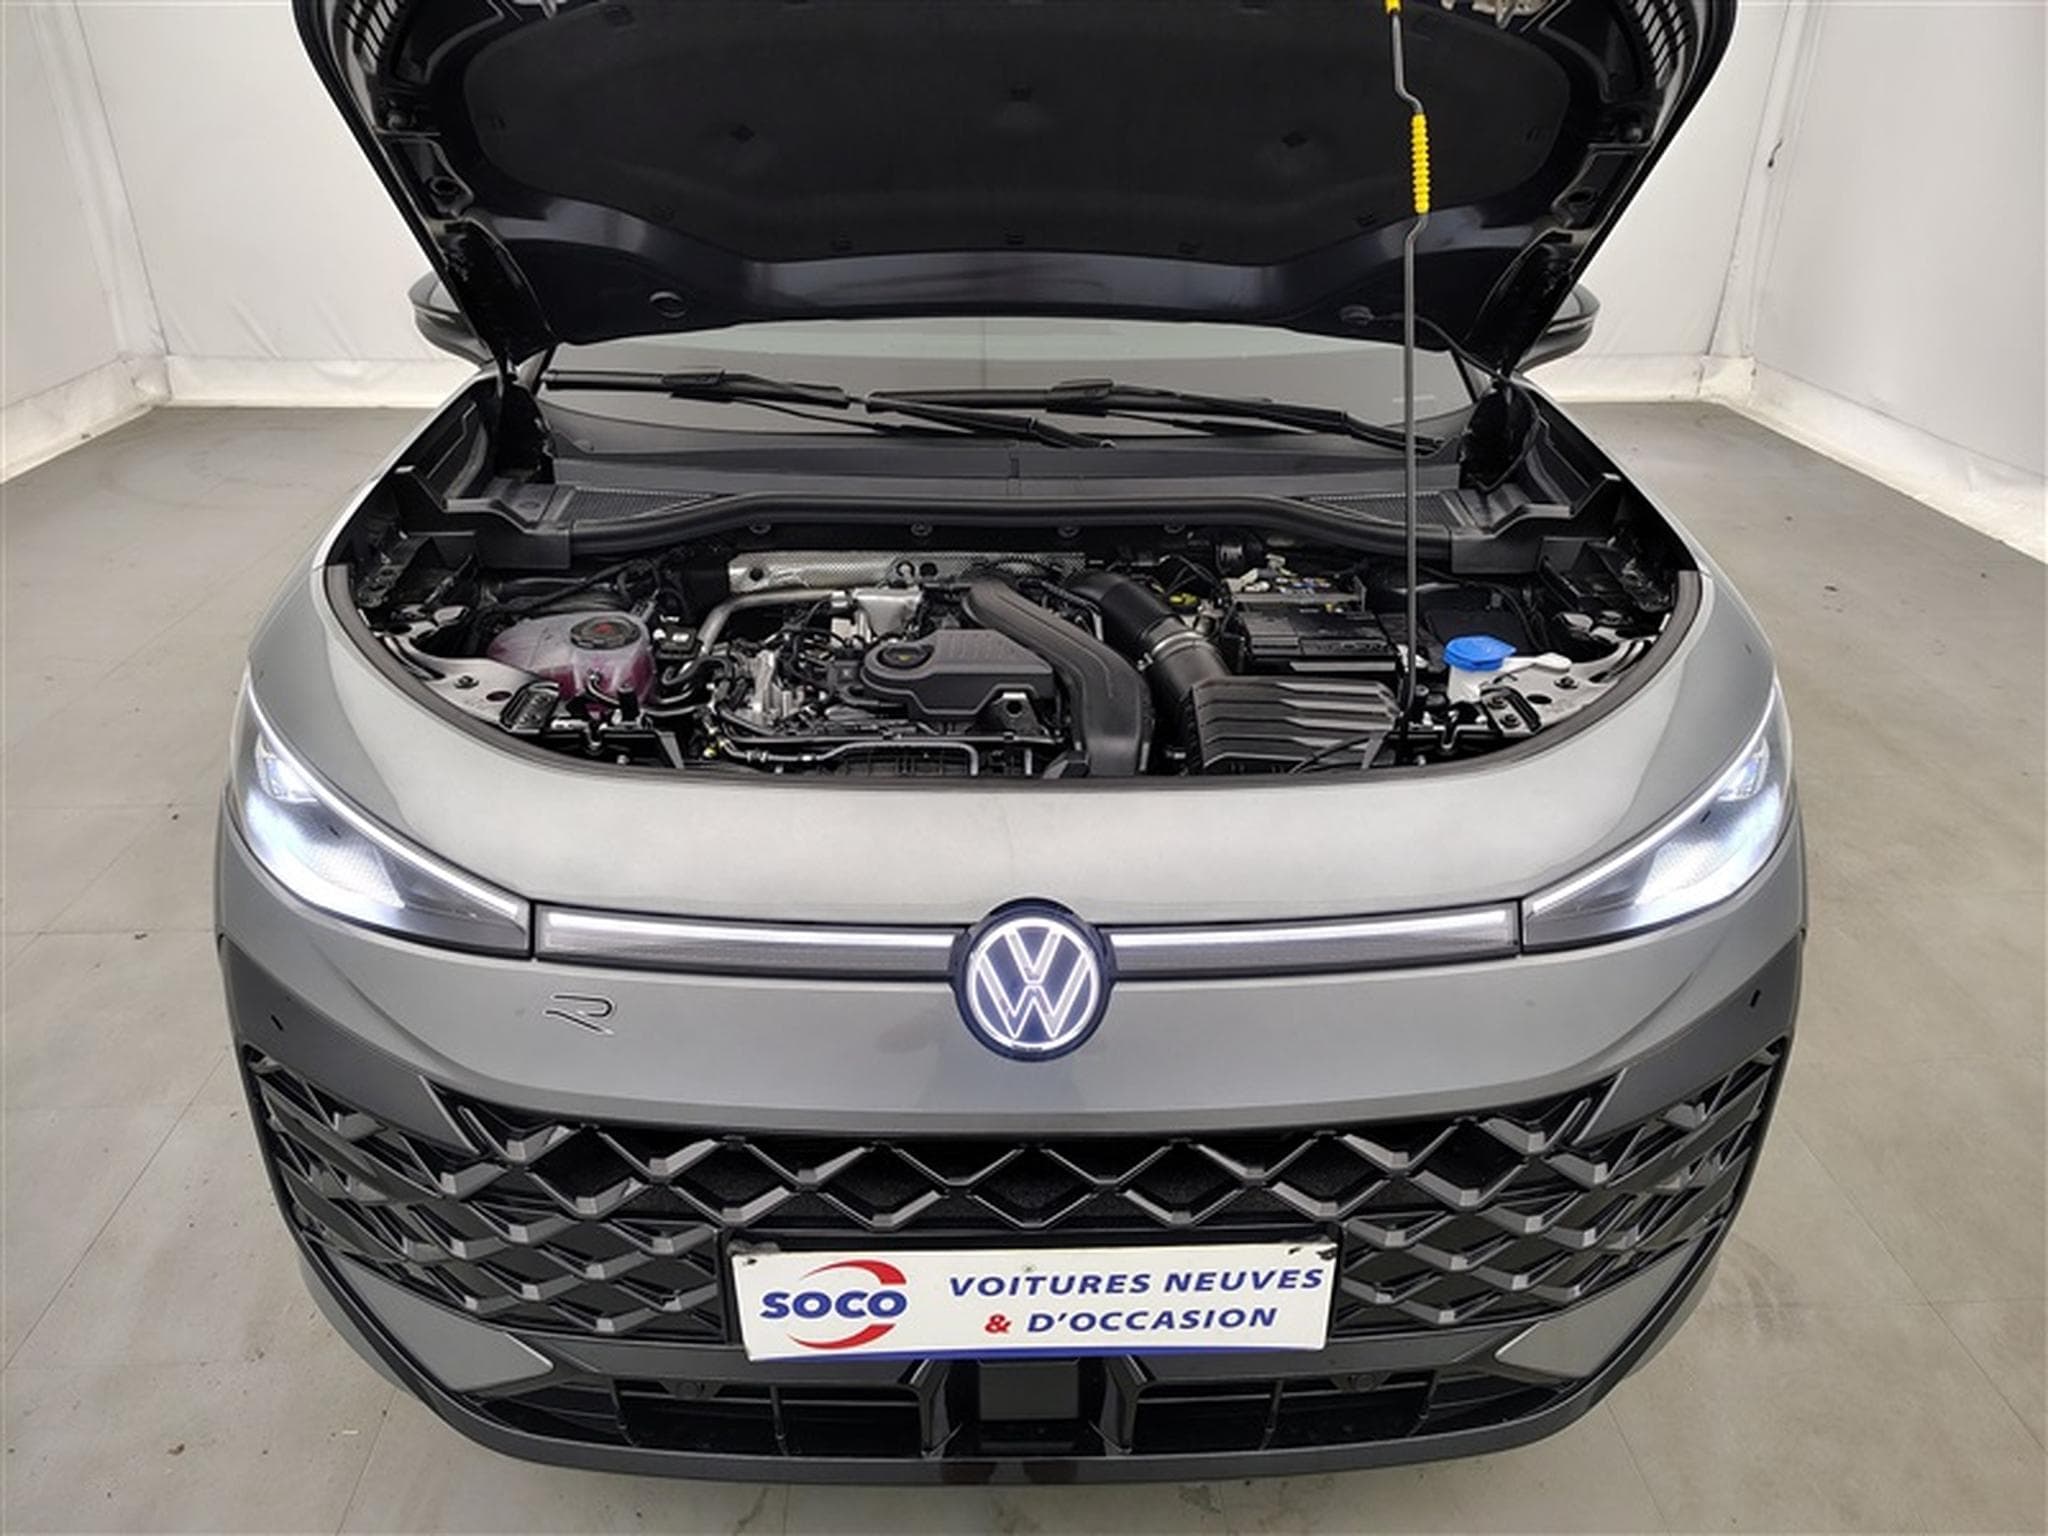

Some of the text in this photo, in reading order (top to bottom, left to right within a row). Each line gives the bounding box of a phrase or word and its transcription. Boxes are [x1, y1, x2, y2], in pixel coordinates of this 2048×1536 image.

[976, 922, 1093, 1040] VW
[950, 1269, 1320, 1297] VOITURES NEUVES
[761, 1290, 908, 1319] SOCO
[983, 1308, 1275, 1334] & D'OCCASION
